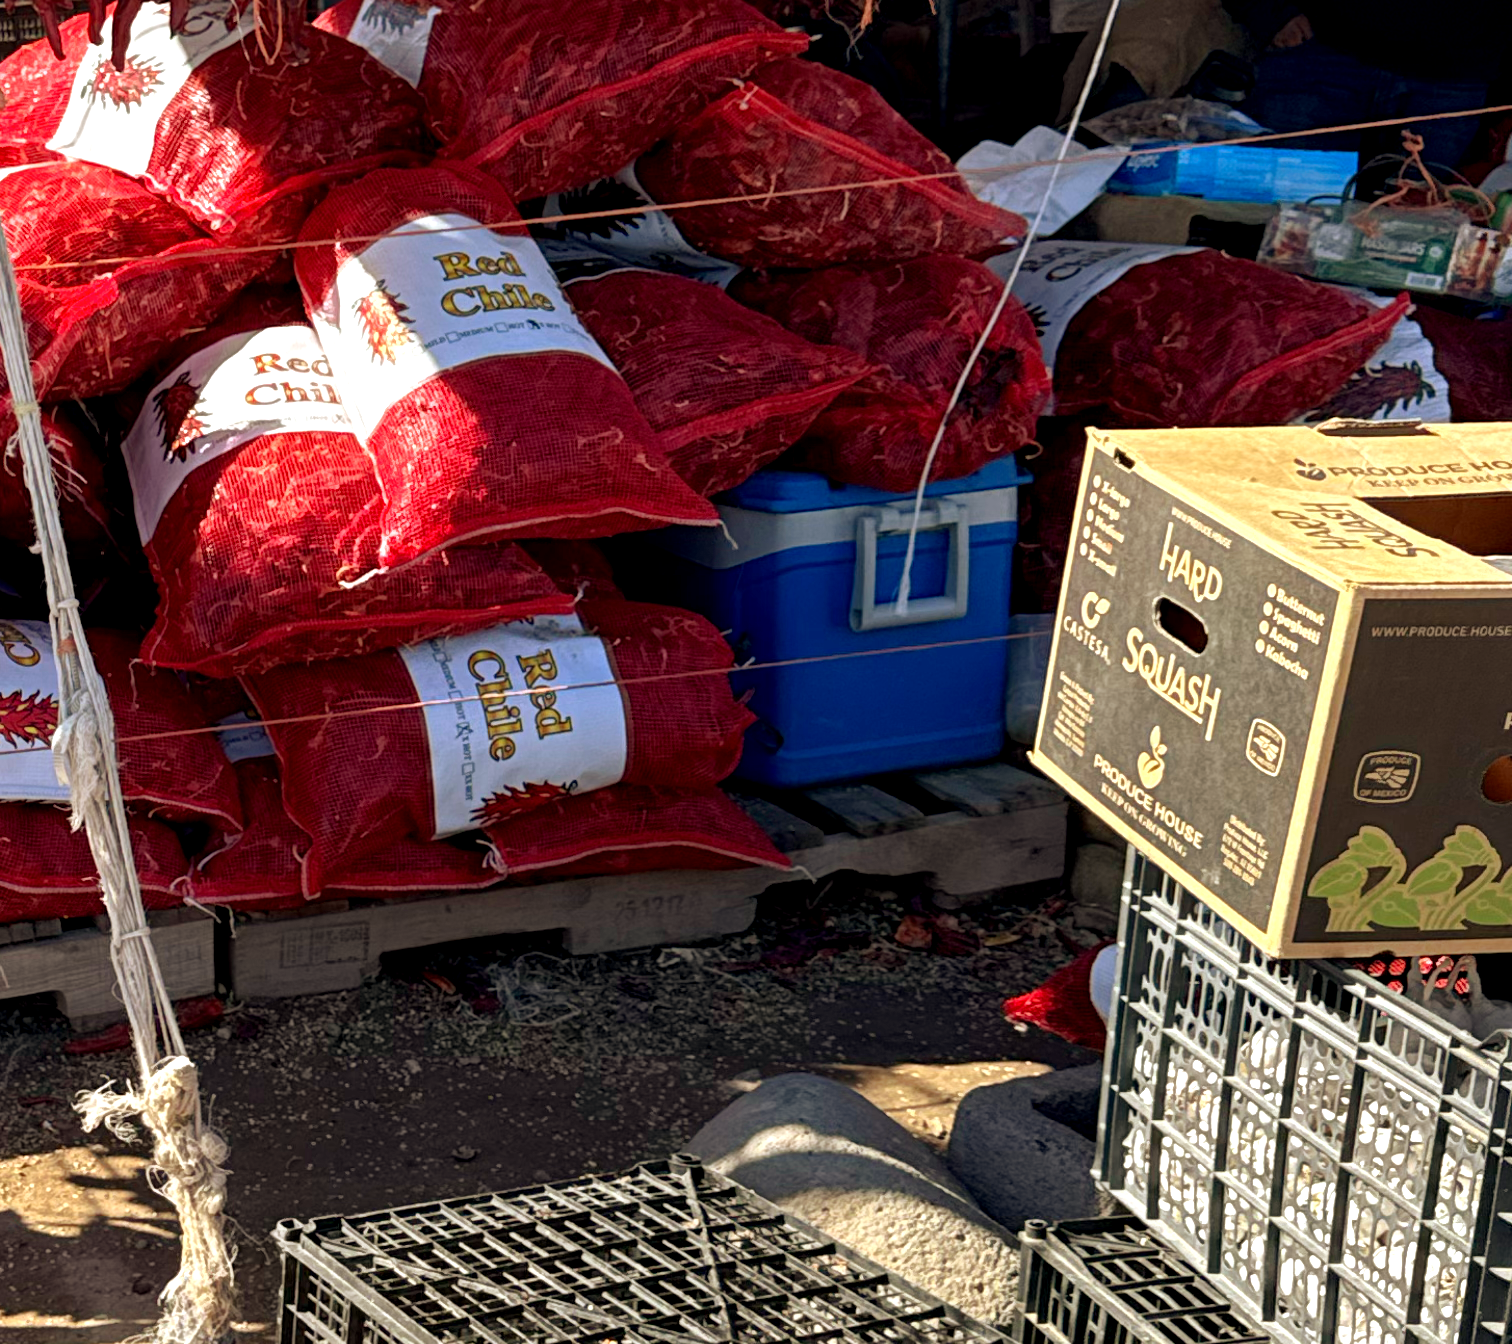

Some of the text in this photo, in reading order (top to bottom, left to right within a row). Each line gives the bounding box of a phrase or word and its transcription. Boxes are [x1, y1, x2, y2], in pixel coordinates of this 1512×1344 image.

[433, 251, 526, 282] Red
[440, 283, 555, 317] Chile
[457, 327, 494, 338] MEDIUM
[249, 353, 334, 378] Red
[245, 382, 343, 406] Chil
[1327, 464, 1468, 478] PRODUCE
[1367, 478, 1420, 488] KEEP
[1423, 476, 1455, 486] ON
[1271, 510, 1366, 550] HARD
[1299, 503, 1441, 558] SQUASH
[1159, 521, 1223, 603] HARD
[1276, 587, 1326, 627] Butternut
[1063, 615, 1110, 662] CASTESA
[1268, 626, 1299, 654] Acorn
[1272, 607, 1321, 646] Spaghetti
[1265, 643, 1309, 681] Kabocha
[516, 649, 573, 740] Red
[1121, 627, 1222, 742] SQUASH
[467, 649, 524, 762] Chile
[463, 743, 473, 761] HOT
[1370, 756, 1413, 765] PRODUCE
[1093, 753, 1205, 850] PRODUCE HOUSE
[1373, 788, 1407, 798] MEXICO
[1123, 802, 1139, 820] ON
[1138, 814, 1188, 858] GROWING
